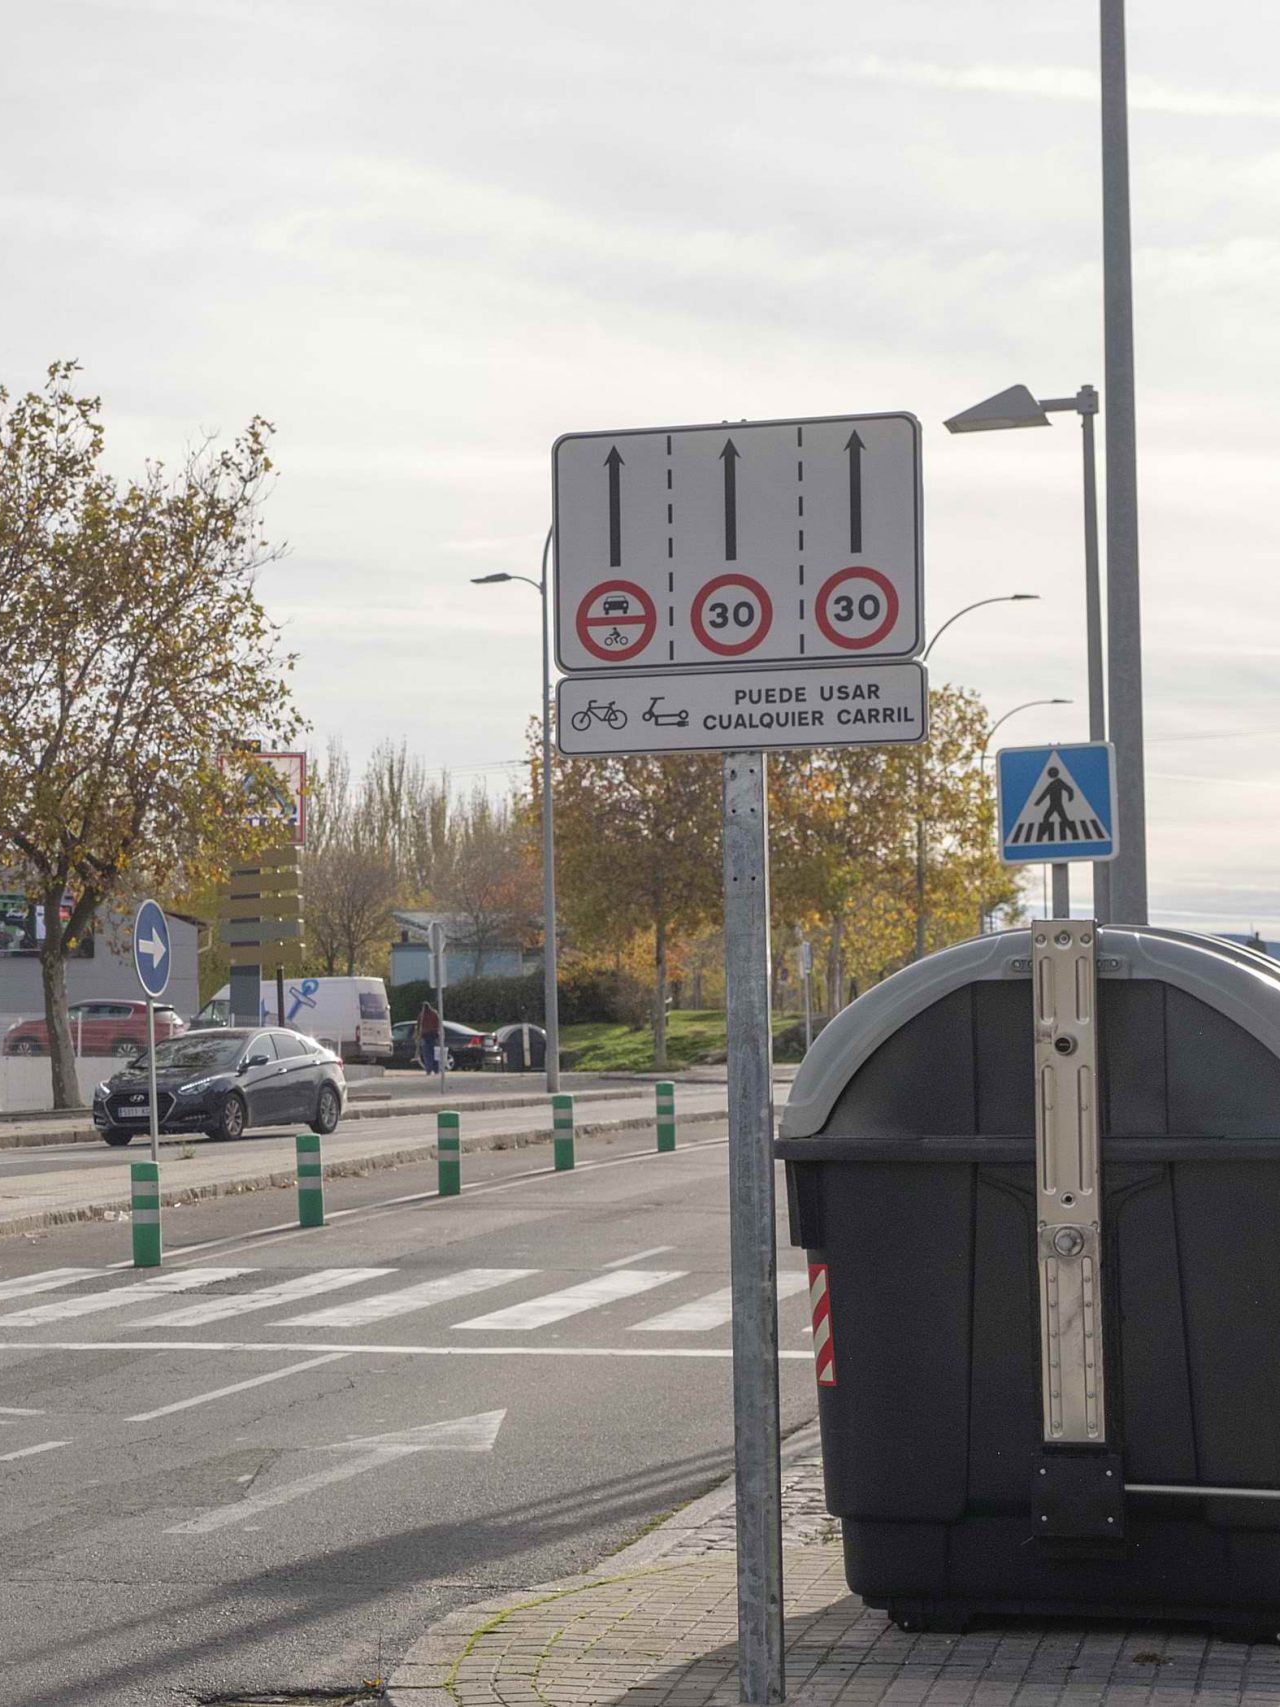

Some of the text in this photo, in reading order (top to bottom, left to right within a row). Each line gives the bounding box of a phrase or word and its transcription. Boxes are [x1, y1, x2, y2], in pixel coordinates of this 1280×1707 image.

[709, 601, 755, 629] 30
[833, 594, 881, 622] 30
[734, 684, 881, 705] PUEDE USAR
[702, 706, 915, 731] CUALQUIER CARRIL
